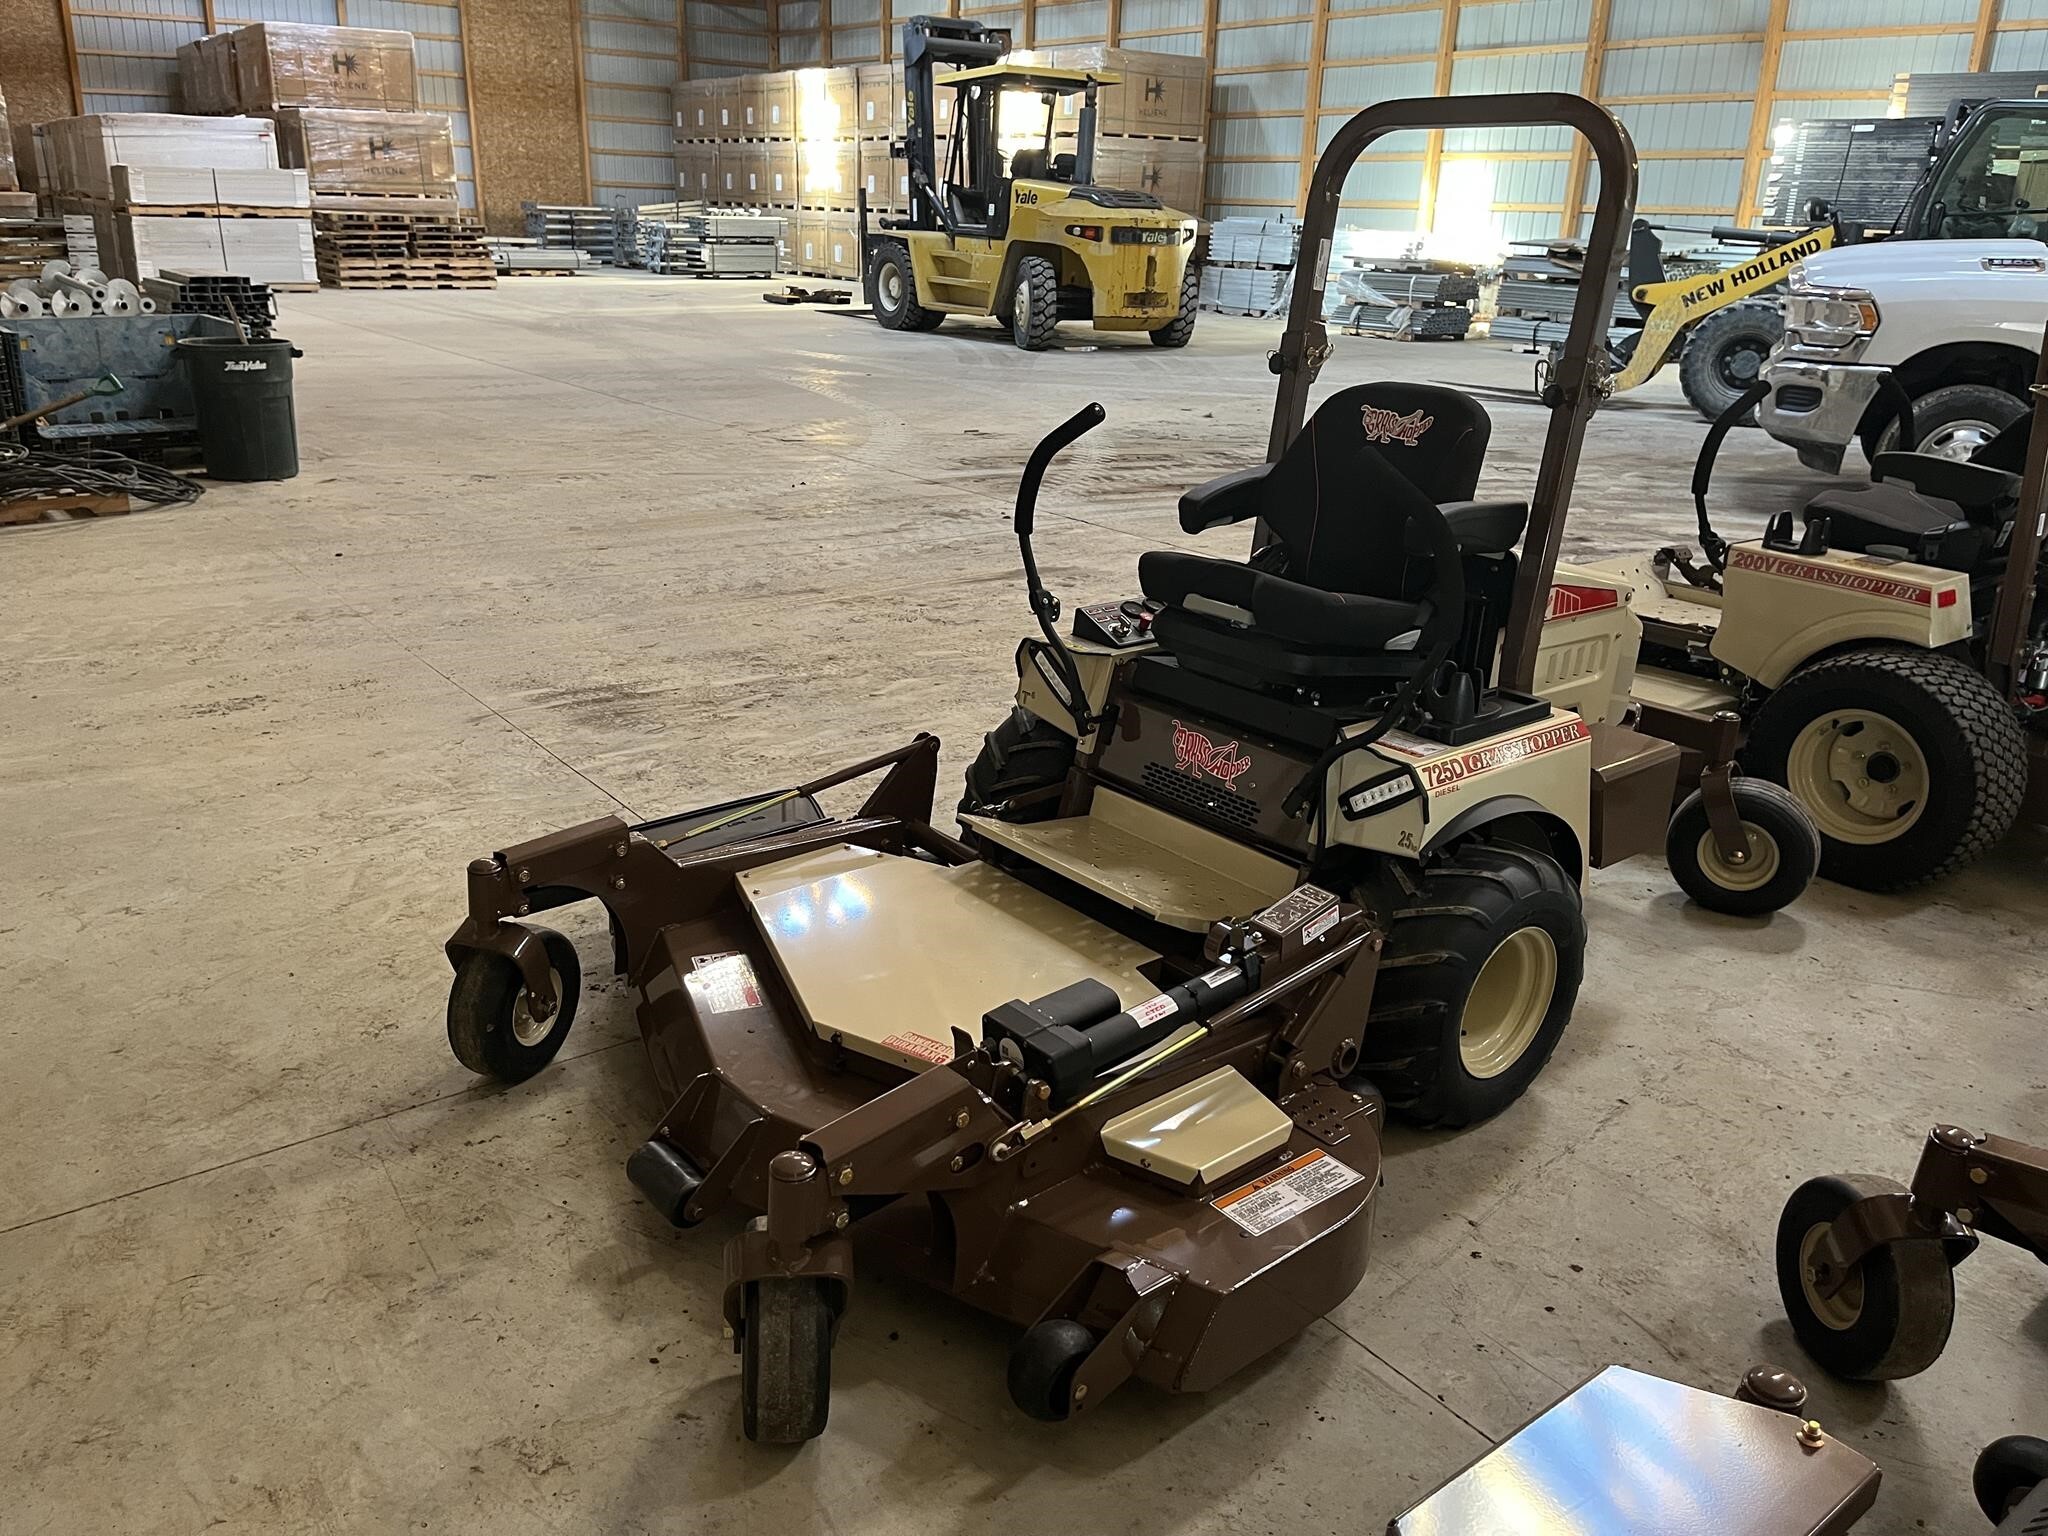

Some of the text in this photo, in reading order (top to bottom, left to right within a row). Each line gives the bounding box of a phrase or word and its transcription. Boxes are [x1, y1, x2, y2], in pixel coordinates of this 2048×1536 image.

[1680, 238, 1821, 308] NEW HOLLAND
[1733, 552, 1920, 600] 200V GRASSHOPPER
[1422, 758, 1464, 787] 725D
[1469, 725, 1580, 772] GRASSHOPPER
[1435, 784, 1460, 798] DIESEL
[1261, 1166, 1295, 1185] WARNING
